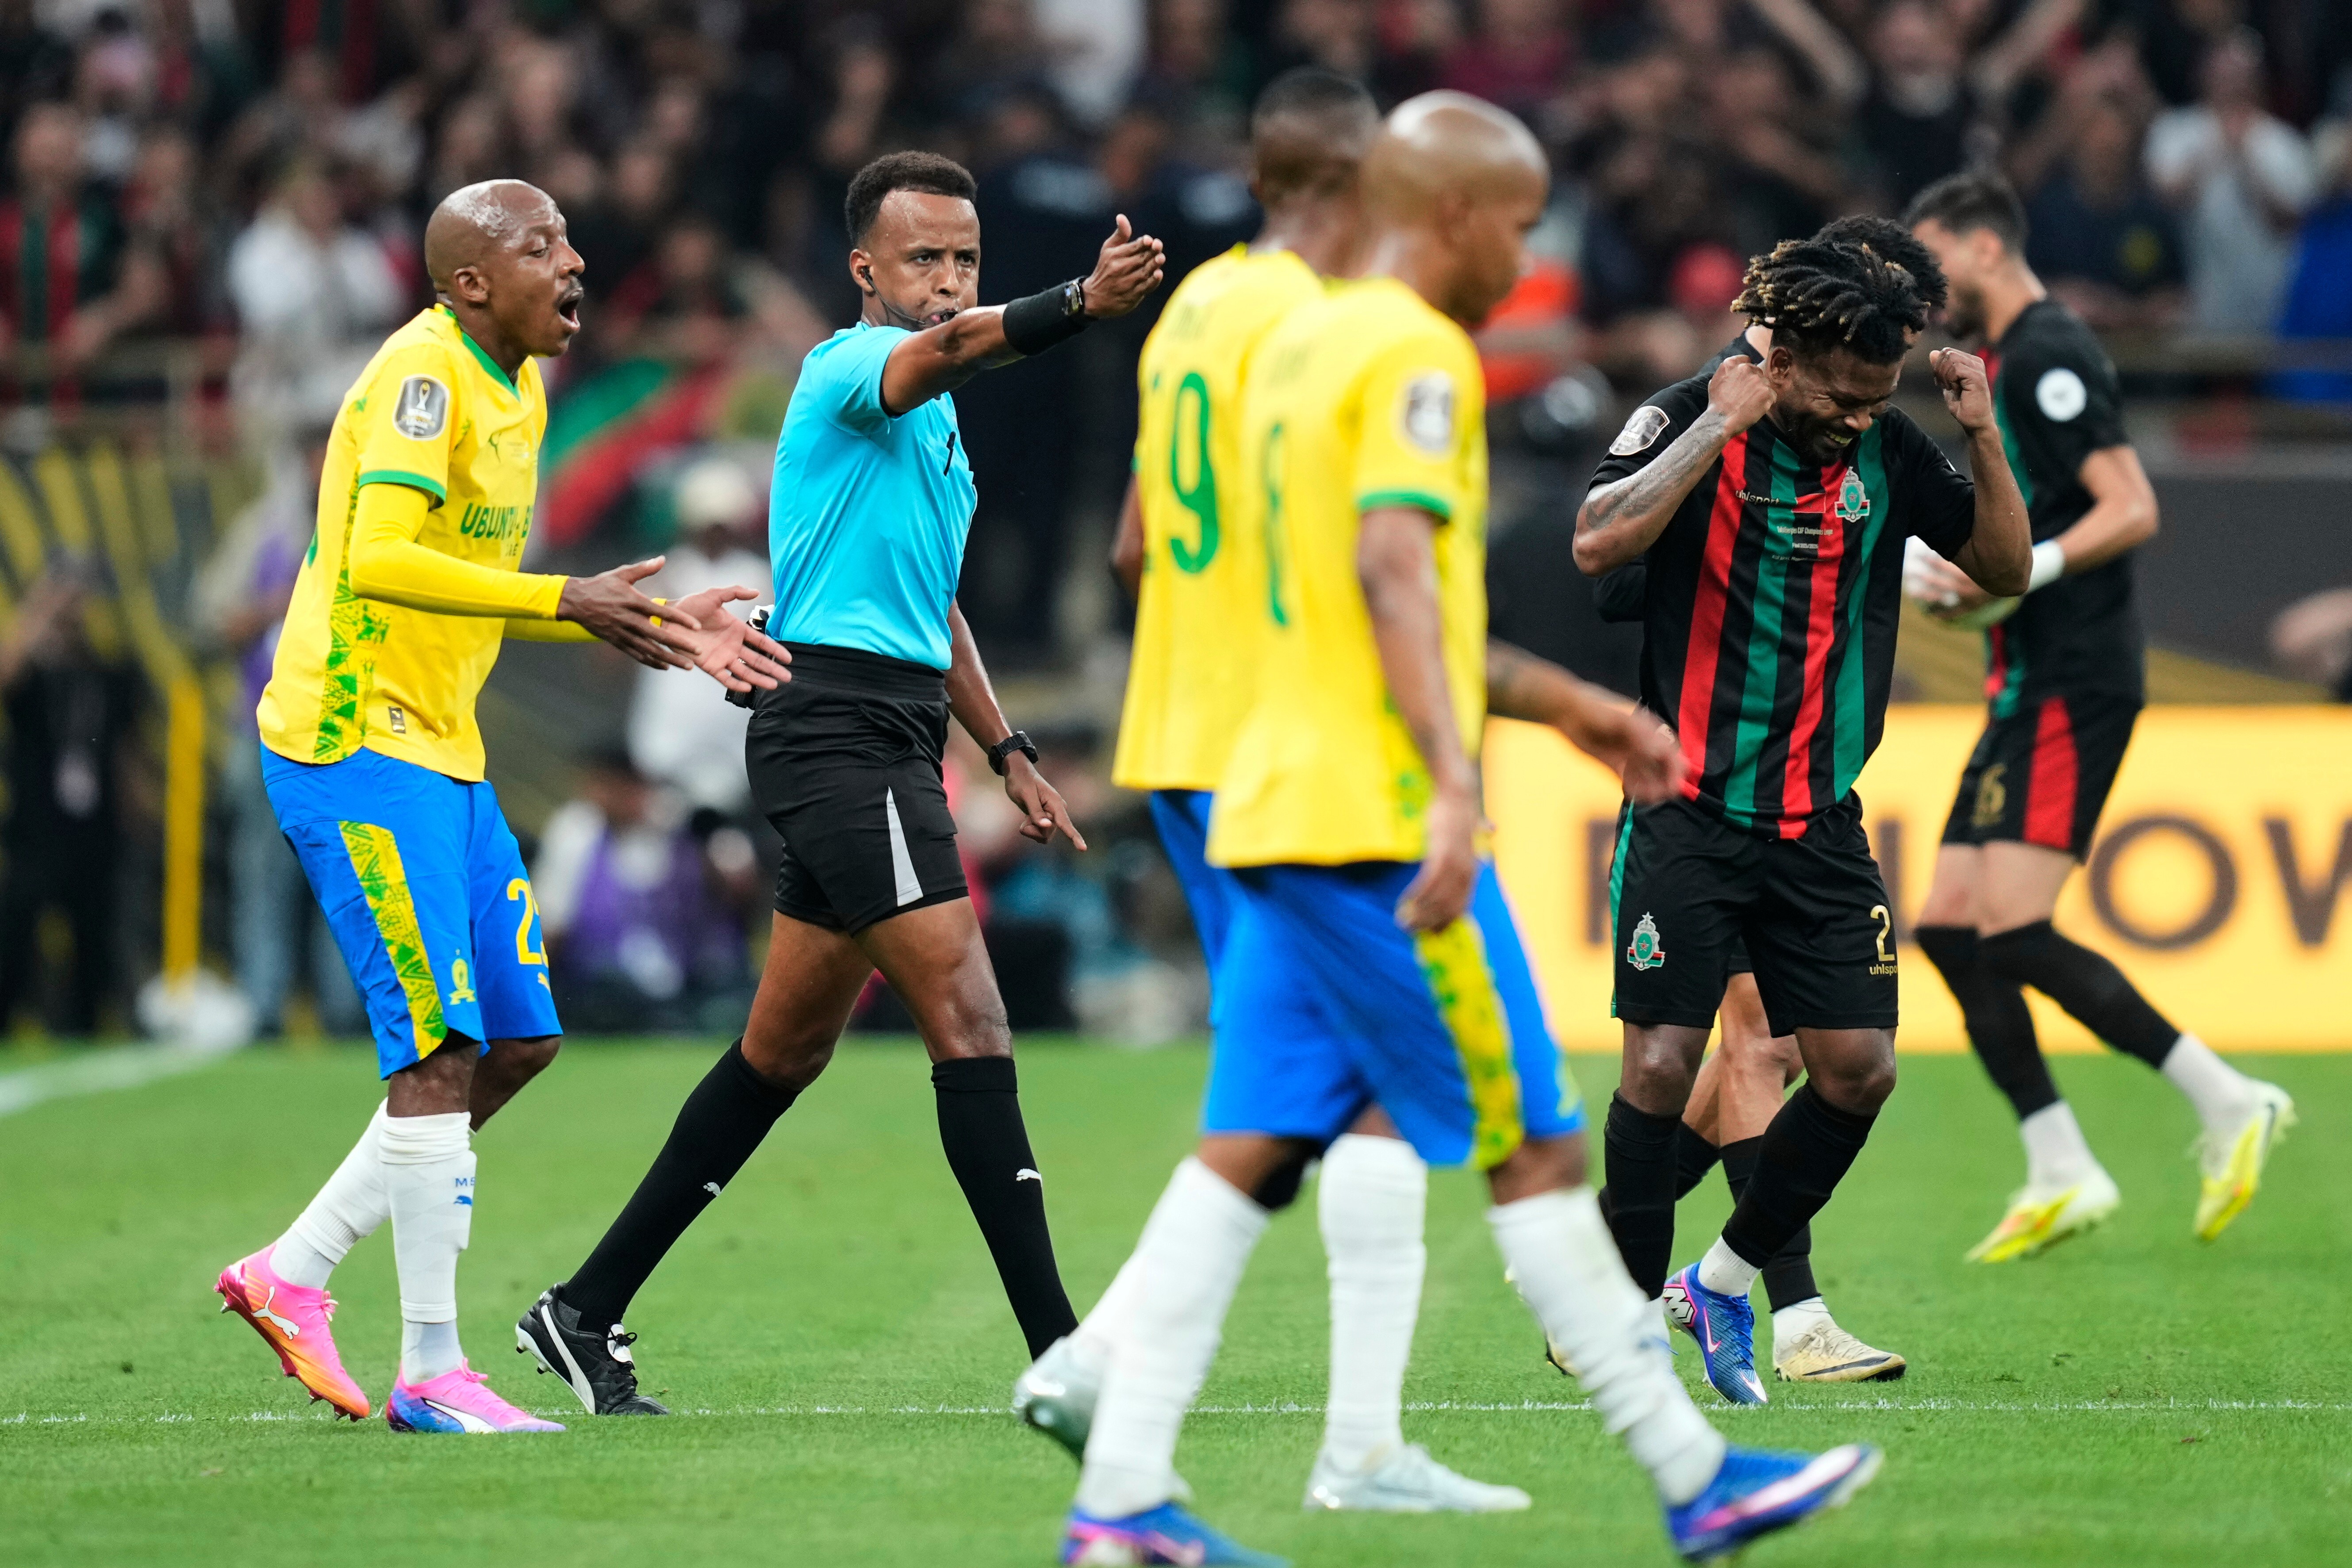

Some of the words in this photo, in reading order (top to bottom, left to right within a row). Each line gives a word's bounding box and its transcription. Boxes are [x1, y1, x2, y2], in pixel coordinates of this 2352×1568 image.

[506, 878, 549, 968] 2
[1870, 905, 1895, 962] 2
[1869, 963, 1898, 977] uhlspo
